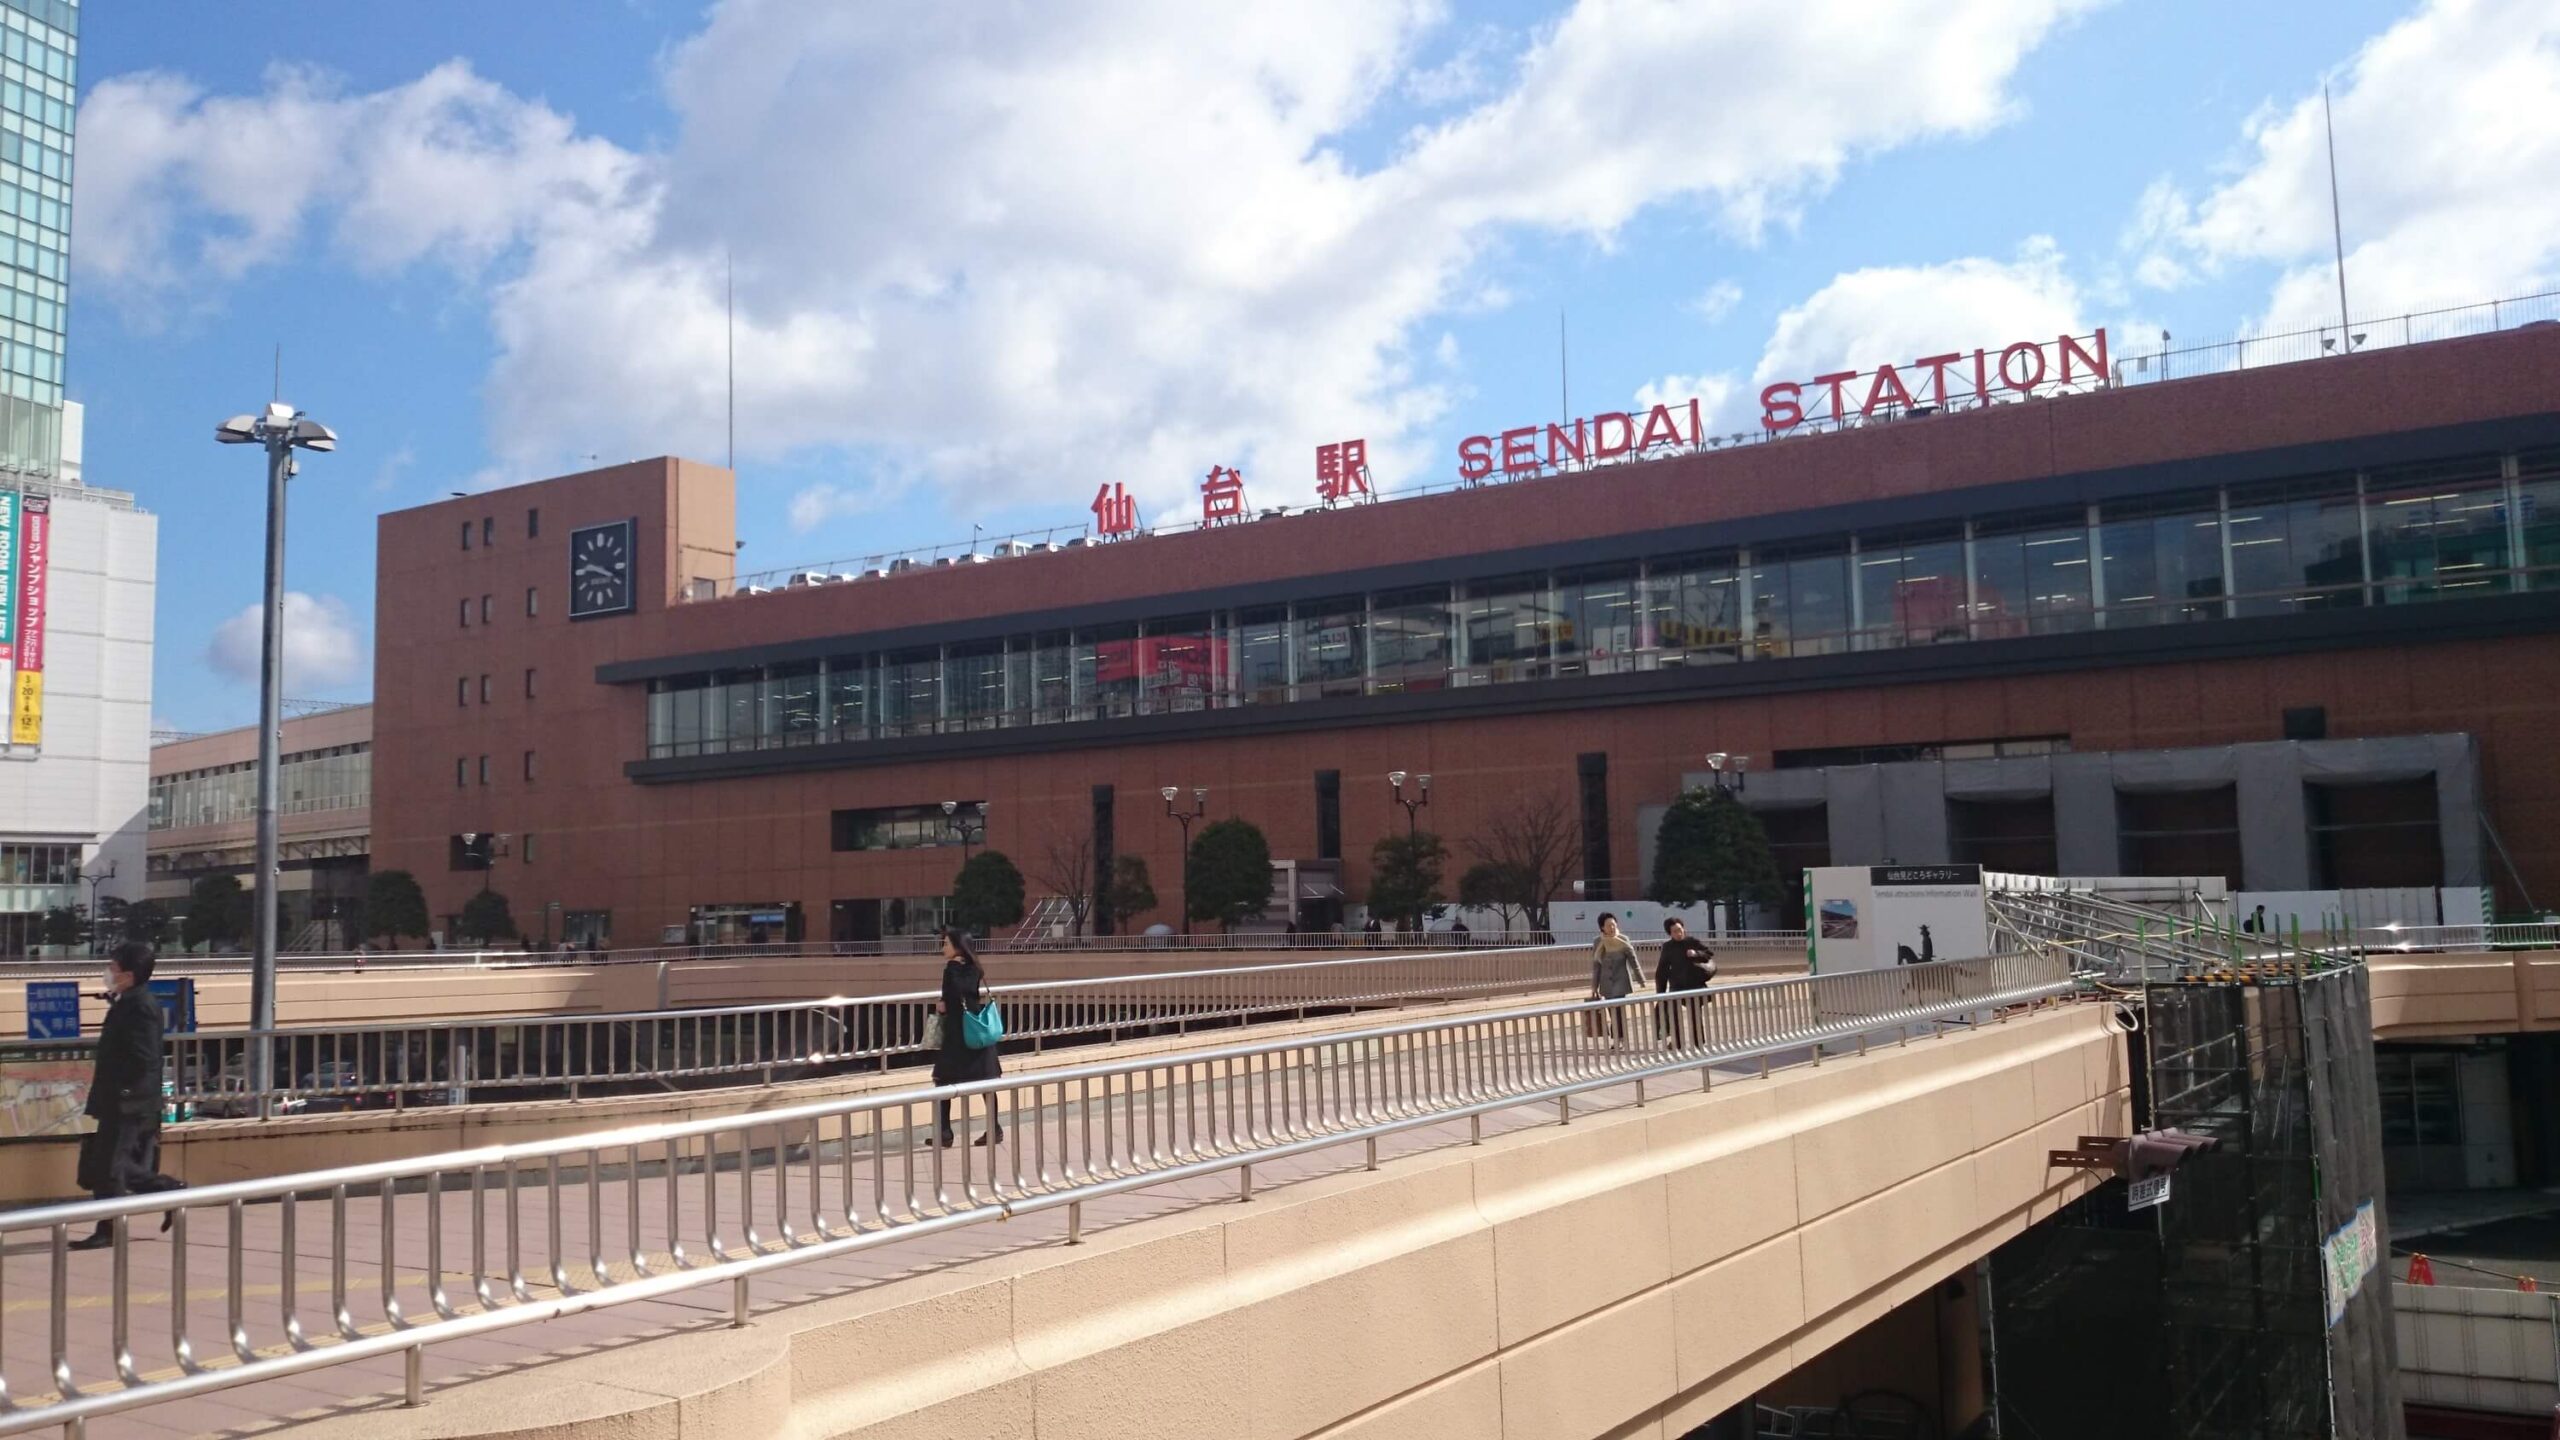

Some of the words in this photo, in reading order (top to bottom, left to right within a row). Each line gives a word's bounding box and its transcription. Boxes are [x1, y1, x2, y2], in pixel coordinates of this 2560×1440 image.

[1458, 398, 1700, 480] SENDAI
[1760, 328, 2110, 431] STATION
[1090, 438, 1370, 534] 仙台駅
[25, 543, 41, 627] ジャンプショップ
